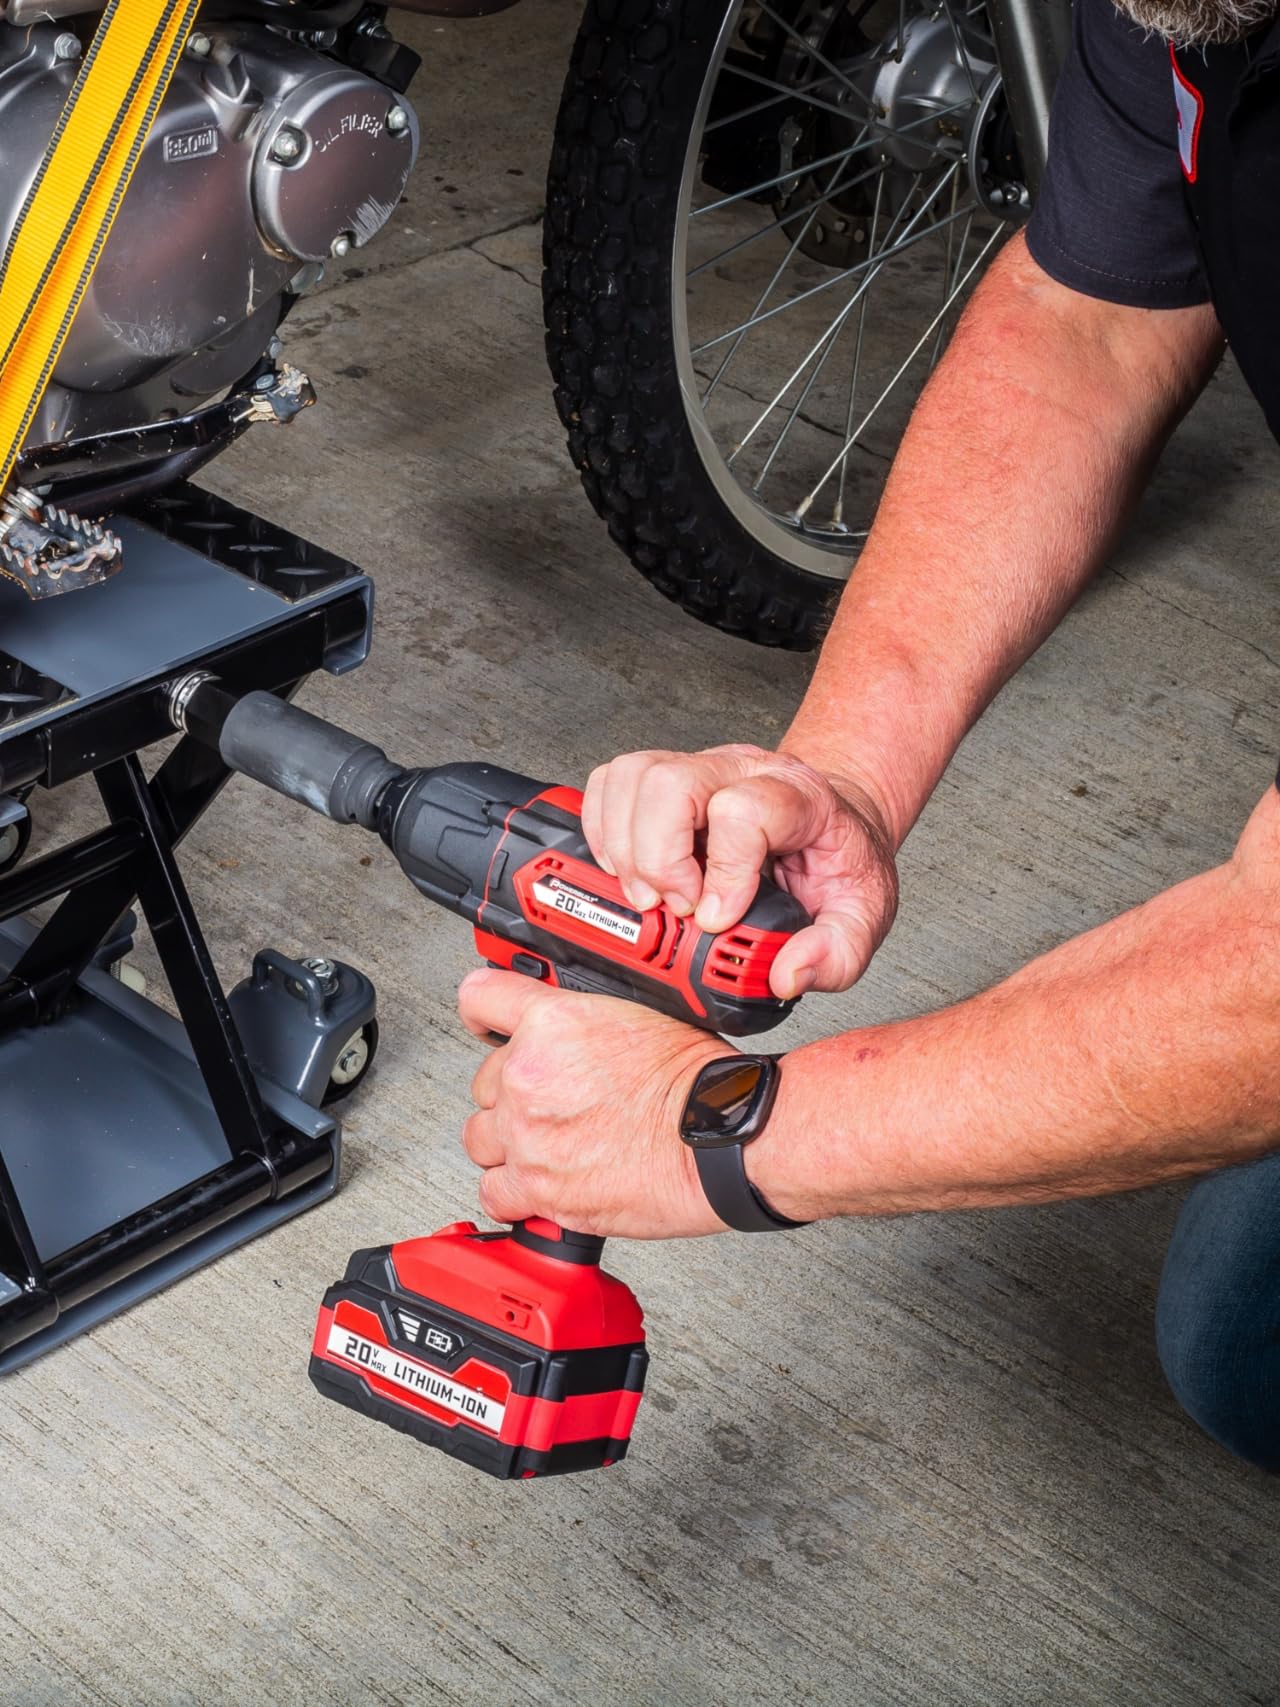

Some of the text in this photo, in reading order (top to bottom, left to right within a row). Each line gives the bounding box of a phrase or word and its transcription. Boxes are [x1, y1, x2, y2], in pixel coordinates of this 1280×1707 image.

[555, 893, 576, 913] 20
[588, 910, 637, 938] LITHIUM-ION
[344, 1335, 371, 1365] 20
[371, 1360, 387, 1374] MAX
[393, 1361, 488, 1419] LITHIUM-ION
